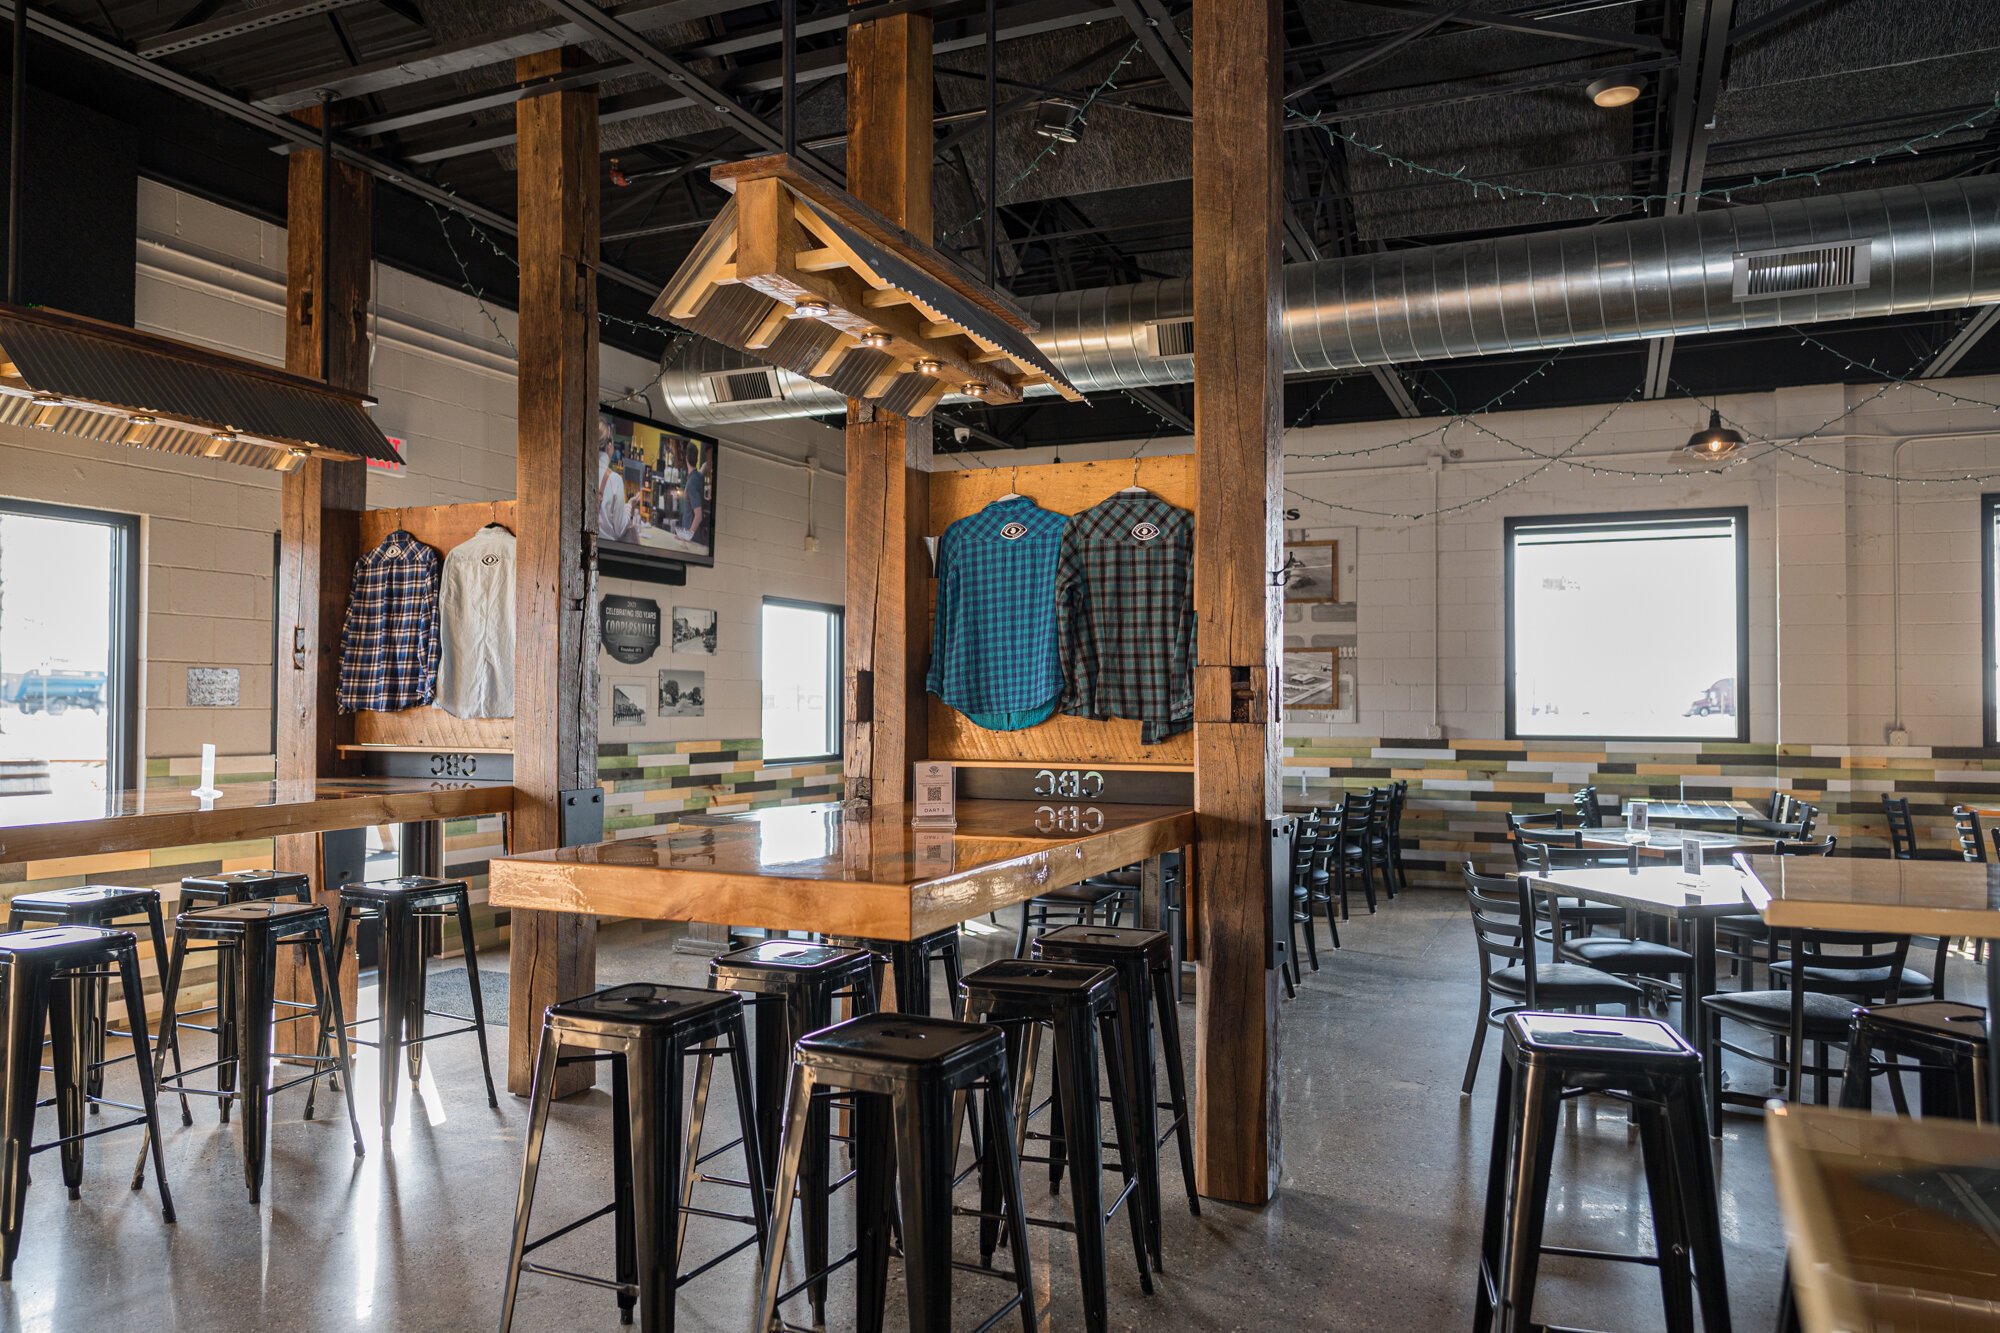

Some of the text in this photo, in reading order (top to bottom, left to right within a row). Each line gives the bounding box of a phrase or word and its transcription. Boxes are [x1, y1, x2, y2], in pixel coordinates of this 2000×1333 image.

[605, 607, 634, 618] CELEBRATING
[643, 611, 657, 620] YEARS
[605, 619, 656, 638] COOPERSVILLE
